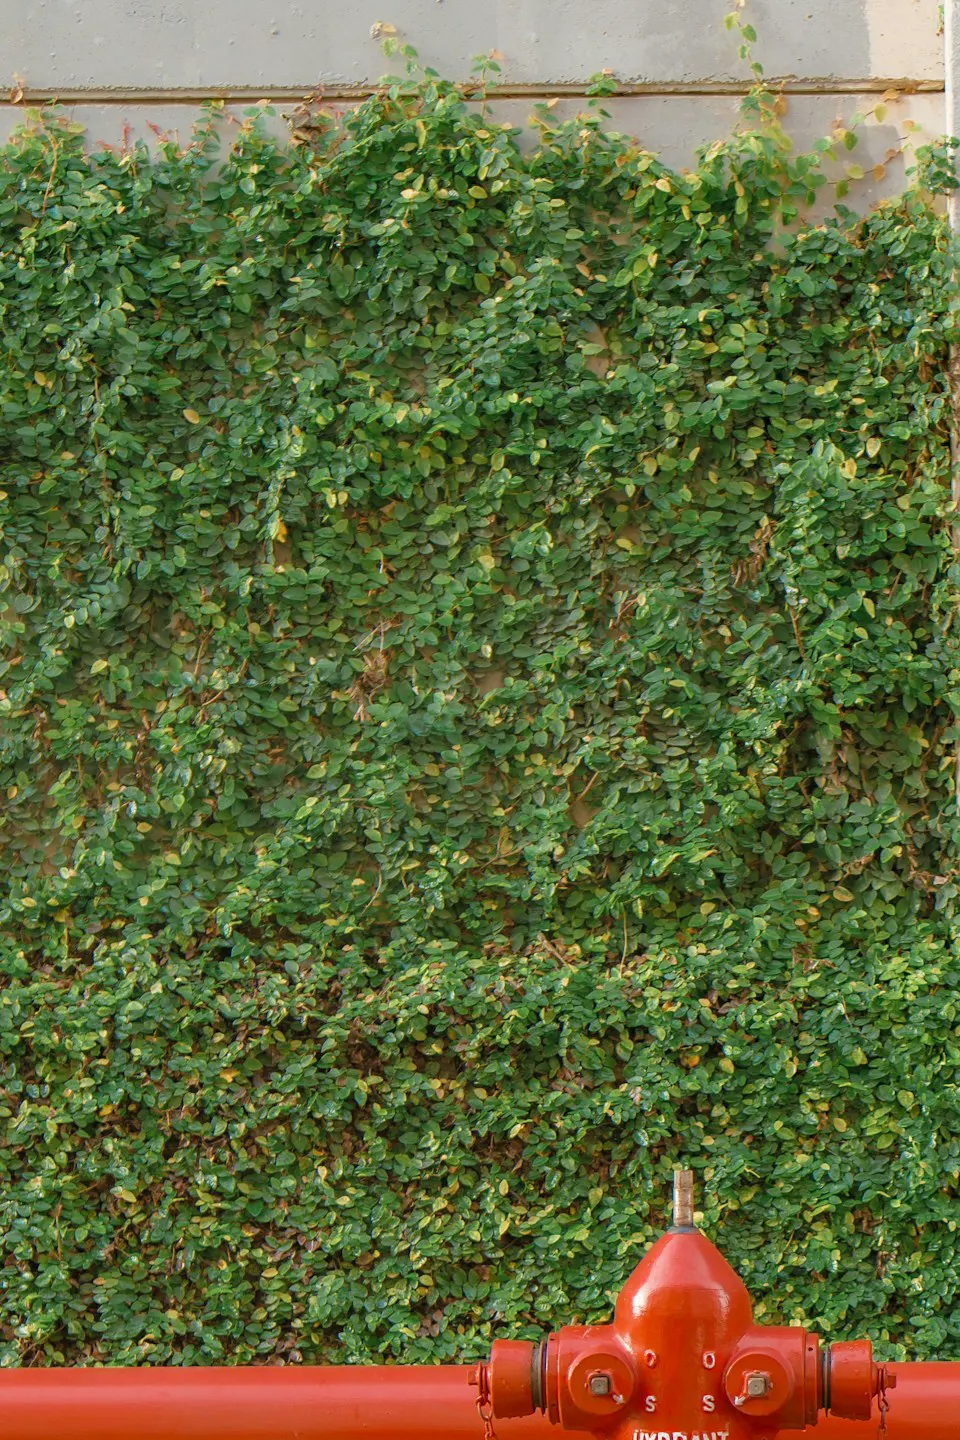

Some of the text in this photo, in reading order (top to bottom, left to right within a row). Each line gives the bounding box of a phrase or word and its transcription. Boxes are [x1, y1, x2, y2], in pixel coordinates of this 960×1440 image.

[702, 1351, 716, 1369] O
[645, 1395, 657, 1413] S
[702, 1394, 716, 1412] S
